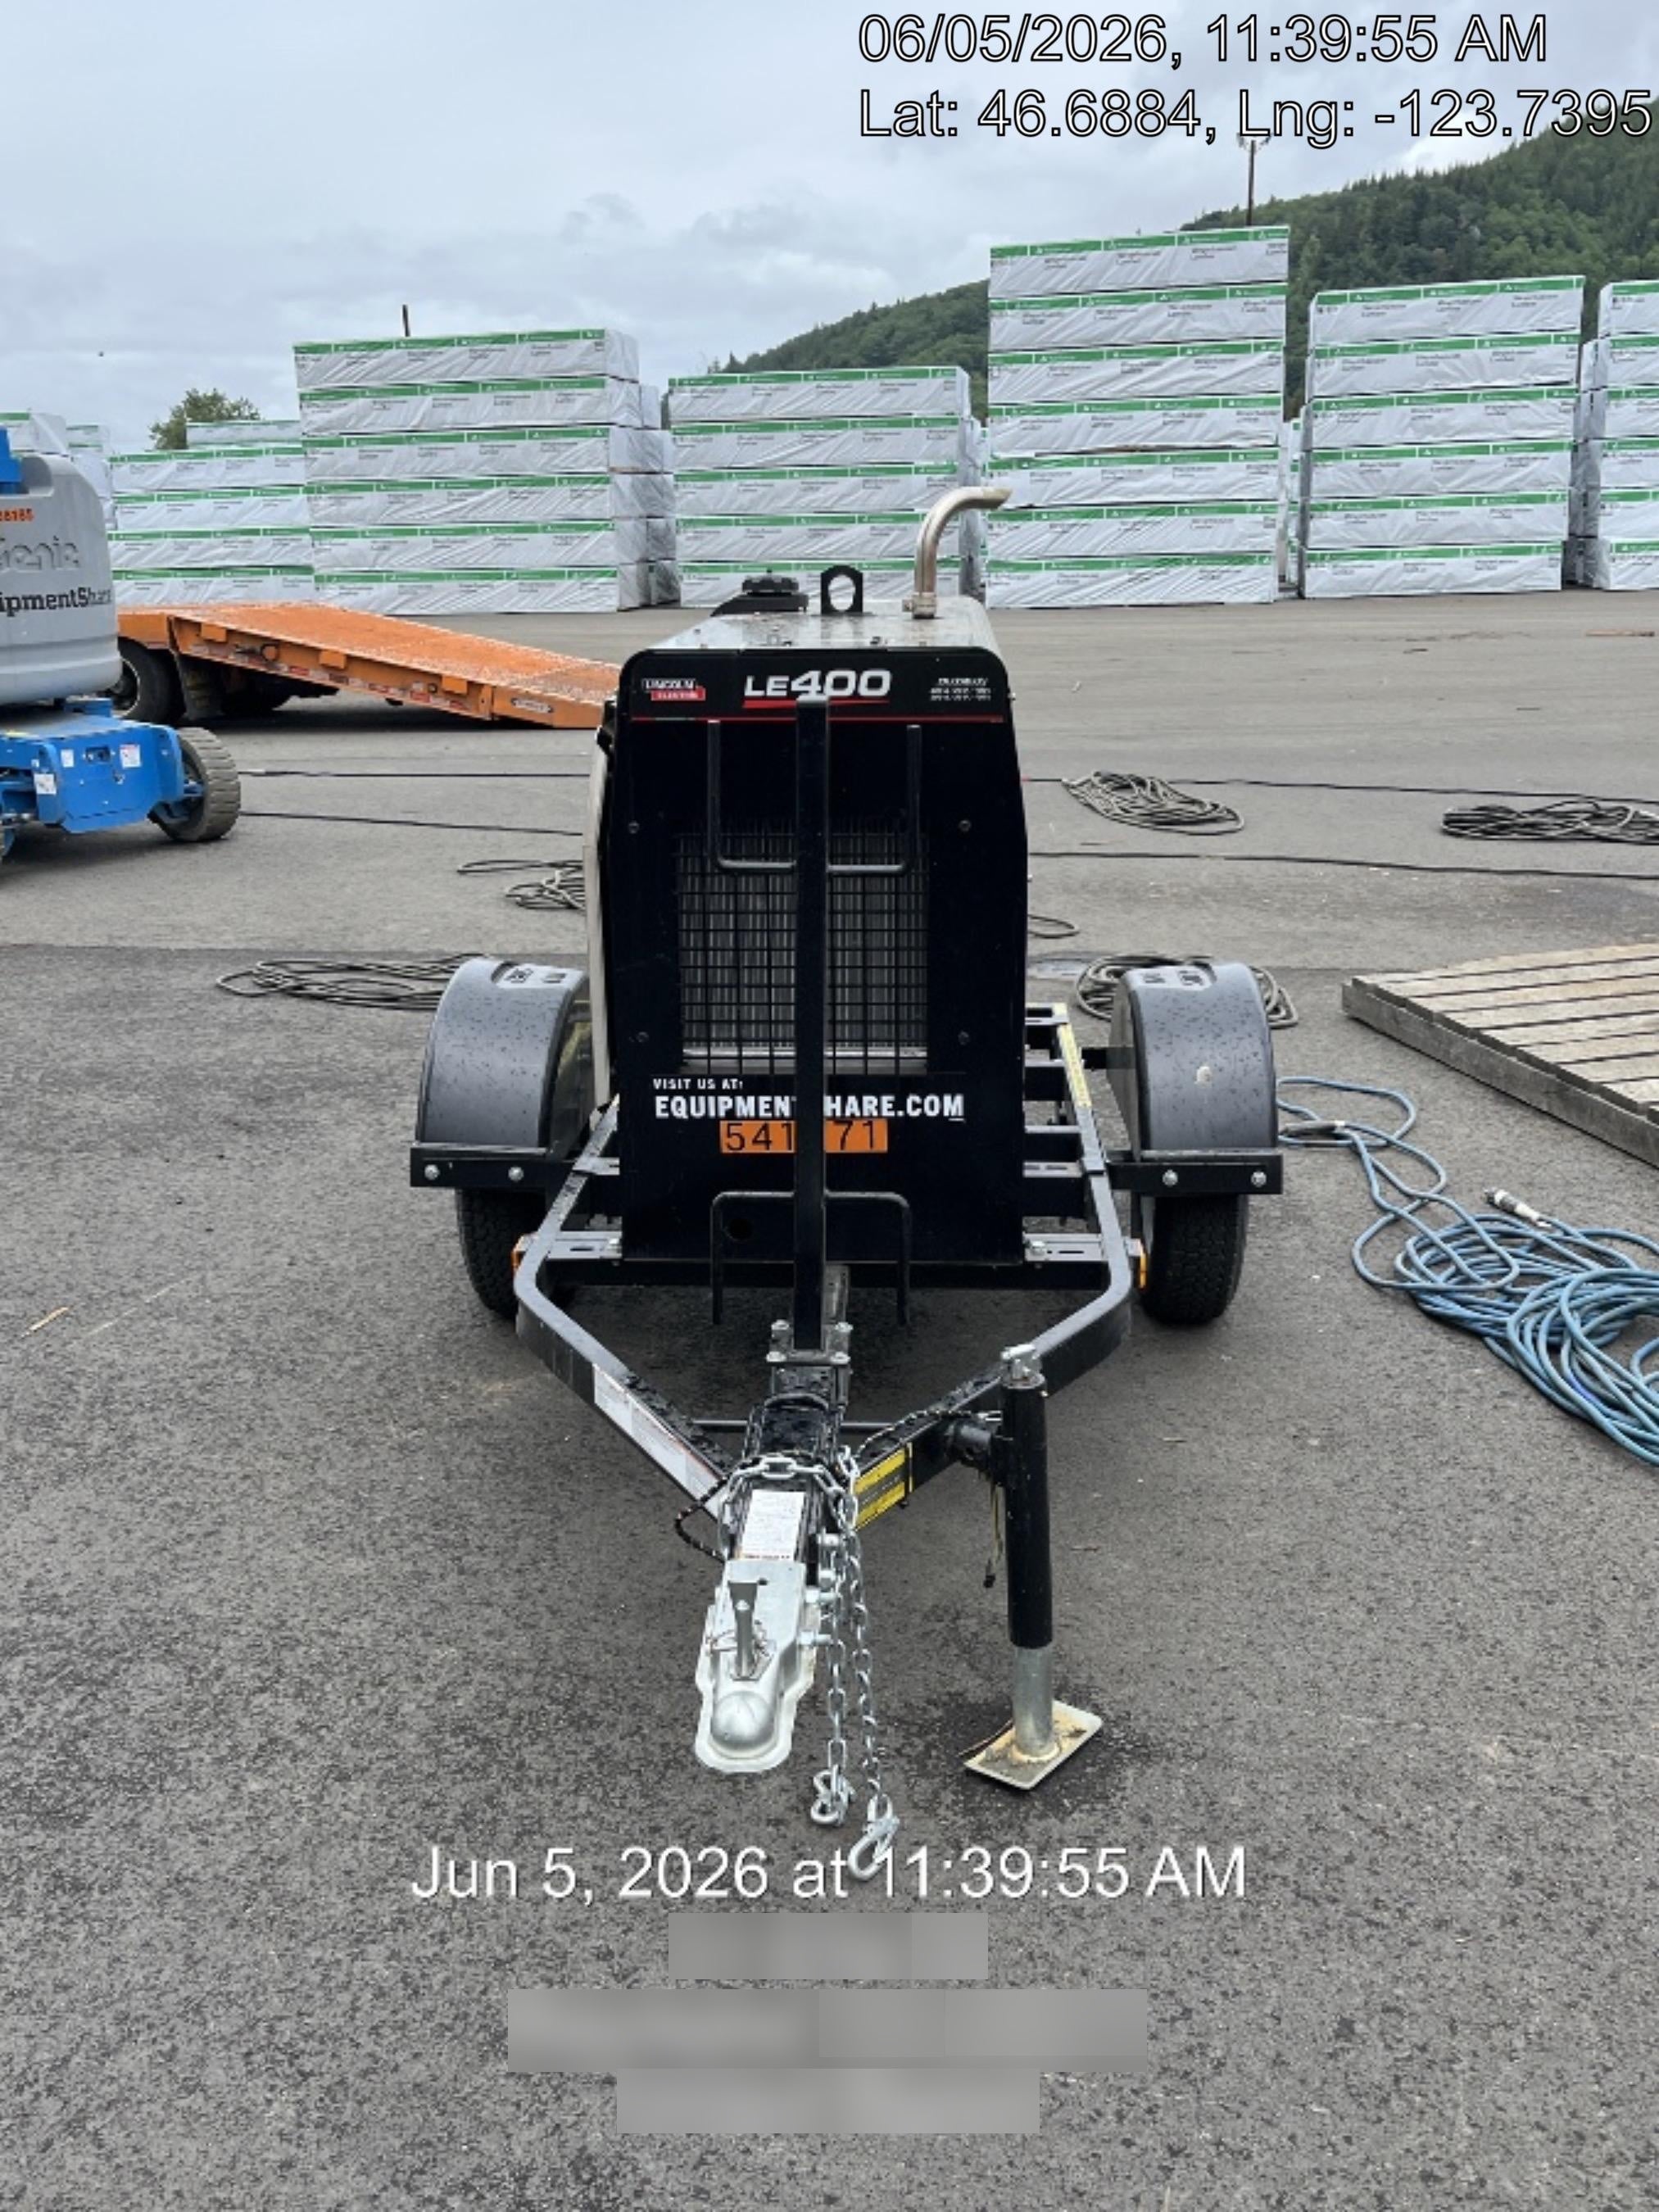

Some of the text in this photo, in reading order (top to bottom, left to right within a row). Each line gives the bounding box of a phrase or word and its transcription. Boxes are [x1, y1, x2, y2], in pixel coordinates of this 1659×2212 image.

[744, 669, 891, 697] LE400
[653, 1078, 691, 1090] VISIT
[697, 1078, 716, 1090] US
[655, 1095, 965, 1119] EQUIPMENHARE.COM
[726, 1122, 874, 1150] 54171
